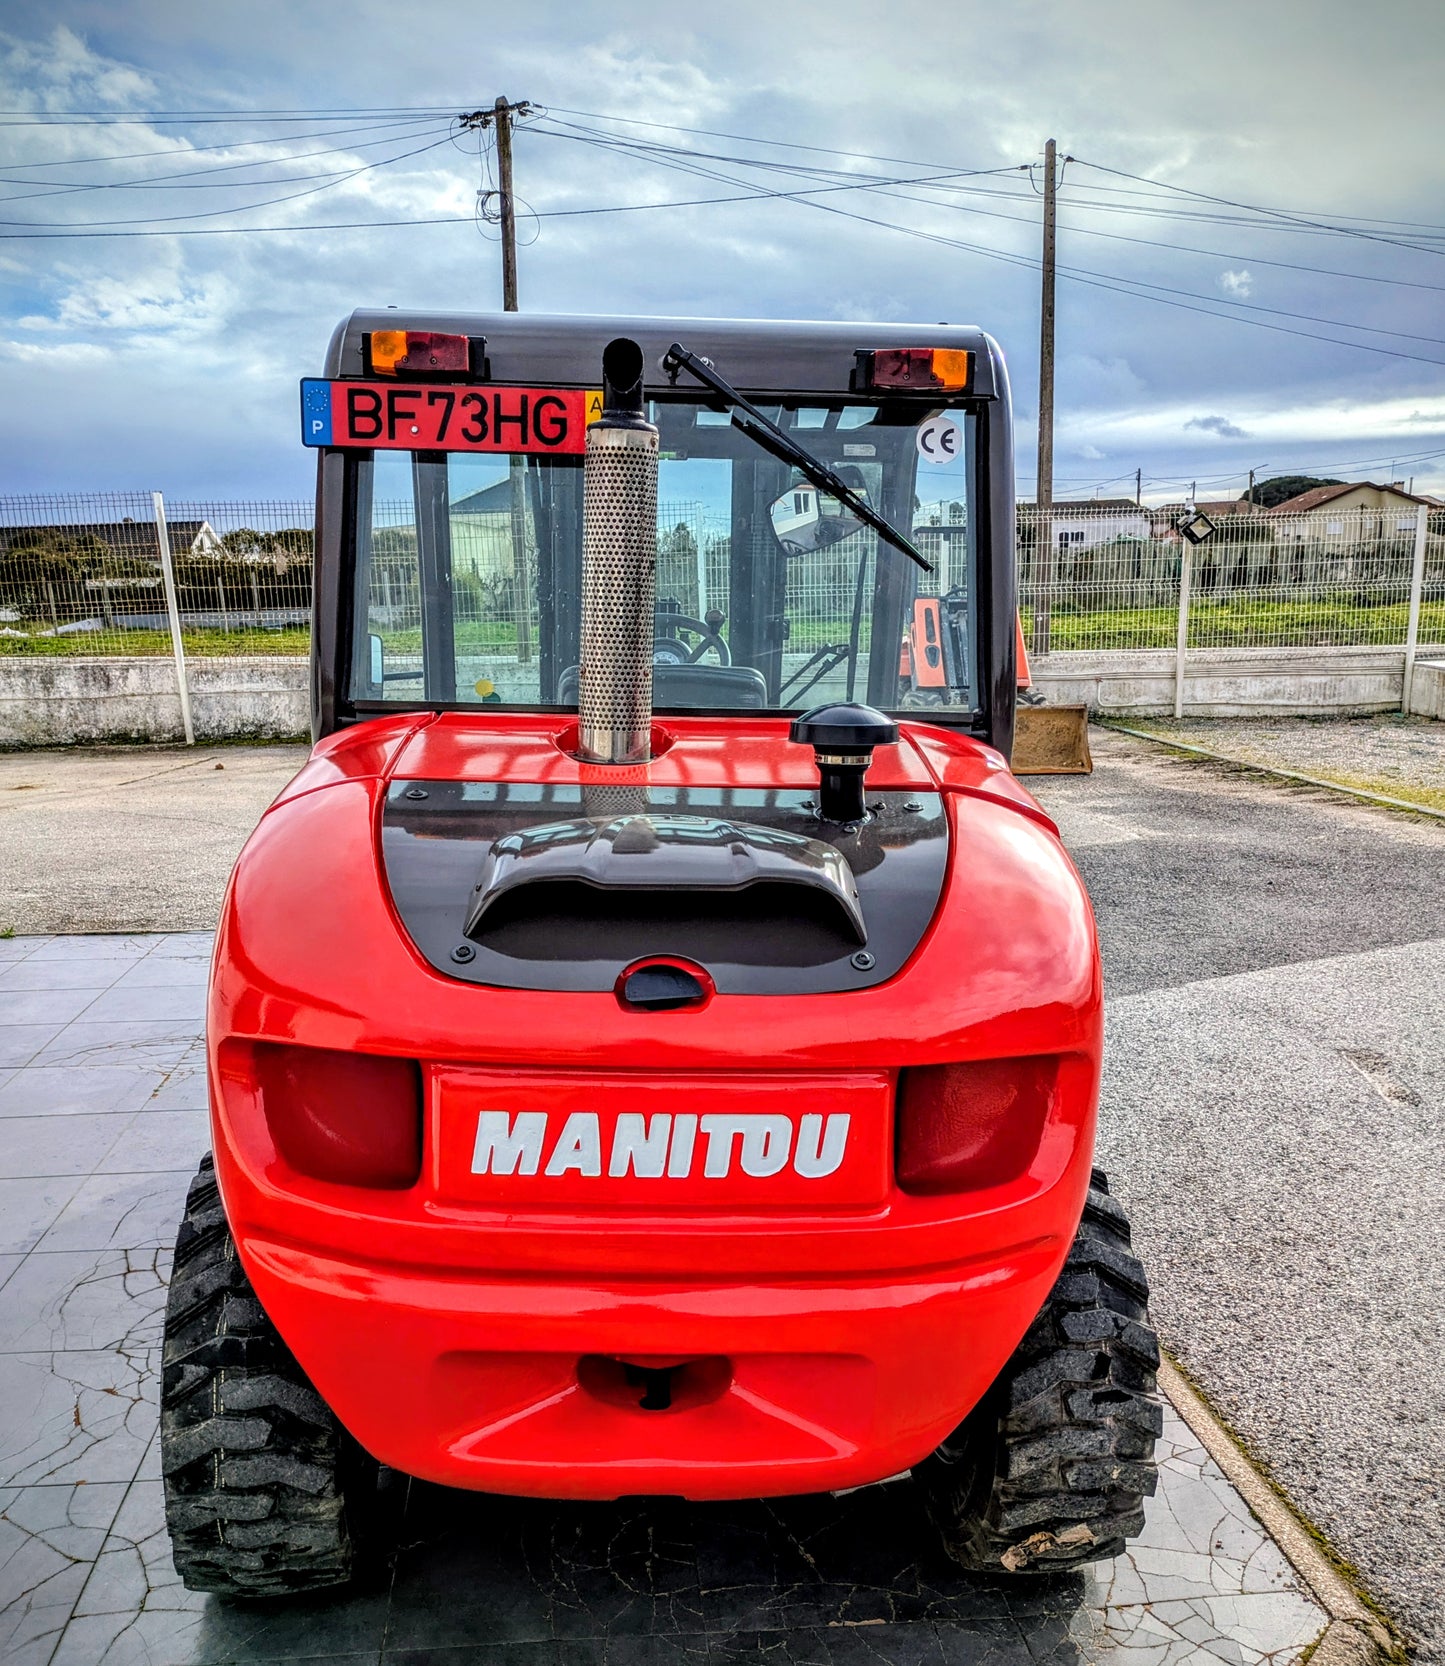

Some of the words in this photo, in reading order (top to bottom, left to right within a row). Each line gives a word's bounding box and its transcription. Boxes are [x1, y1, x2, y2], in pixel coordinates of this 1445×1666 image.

[312, 420, 324, 434] P
[347, 388, 568, 446] BF73HG
[921, 428, 955, 454] CE
[471, 1111, 850, 1178] MANITOU
